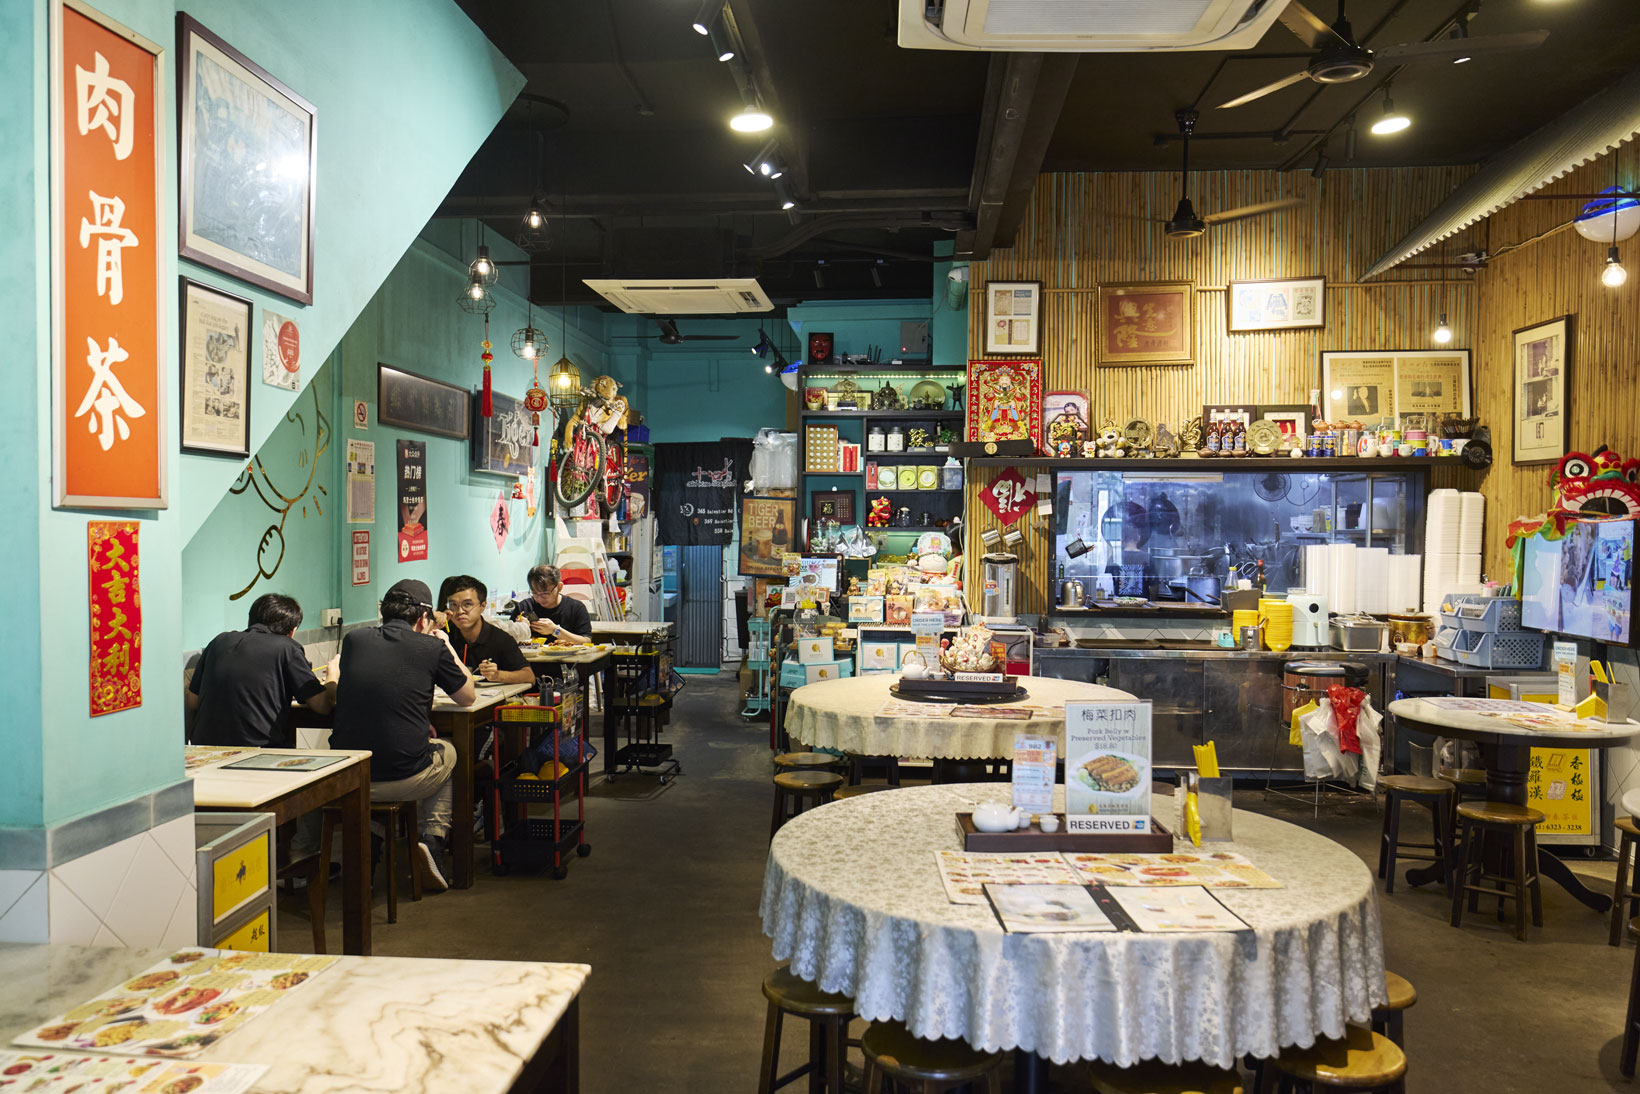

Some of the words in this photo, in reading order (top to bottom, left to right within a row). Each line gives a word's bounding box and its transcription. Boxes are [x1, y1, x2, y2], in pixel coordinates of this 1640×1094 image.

[75, 52, 145, 450] 肉骨茶
[748, 504, 778, 516] TIGER
[748, 516, 775, 528] BEER
[102, 537, 132, 675] 大吉大利
[1081, 709, 1136, 721] 梅菜扣肉
[1070, 821, 1130, 830] RESERVED
